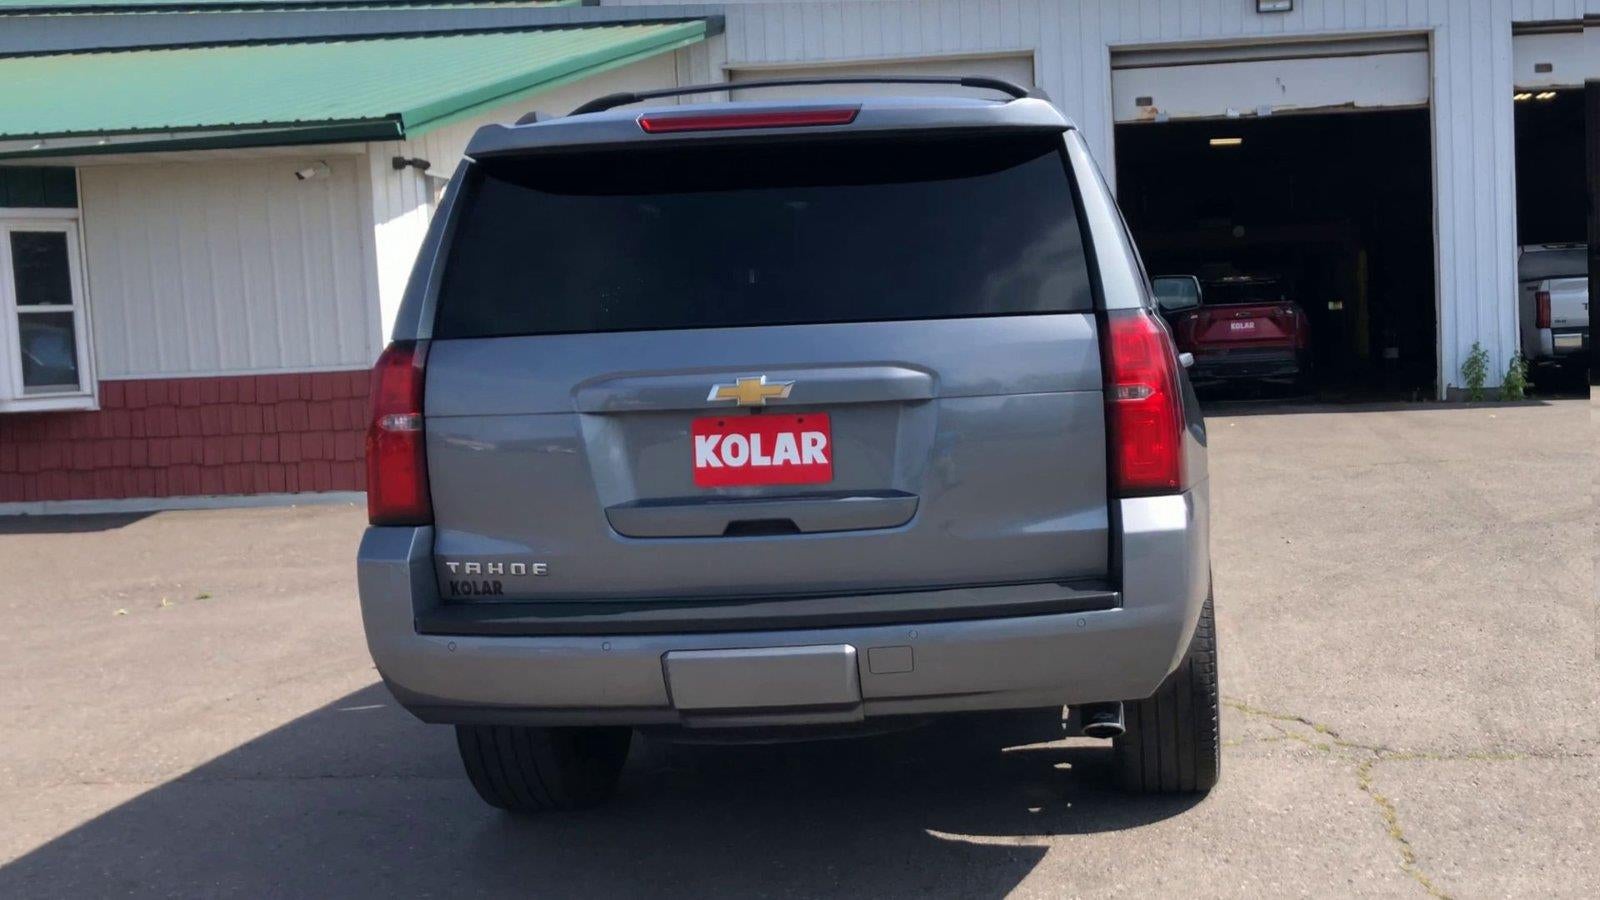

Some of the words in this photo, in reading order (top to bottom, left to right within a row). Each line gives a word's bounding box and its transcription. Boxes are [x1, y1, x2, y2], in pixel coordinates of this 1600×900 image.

[1230, 321, 1255, 330] KOLAR
[695, 431, 828, 468] KOLAR
[446, 562, 547, 575] TAHOE
[450, 580, 503, 595] KOLAR
